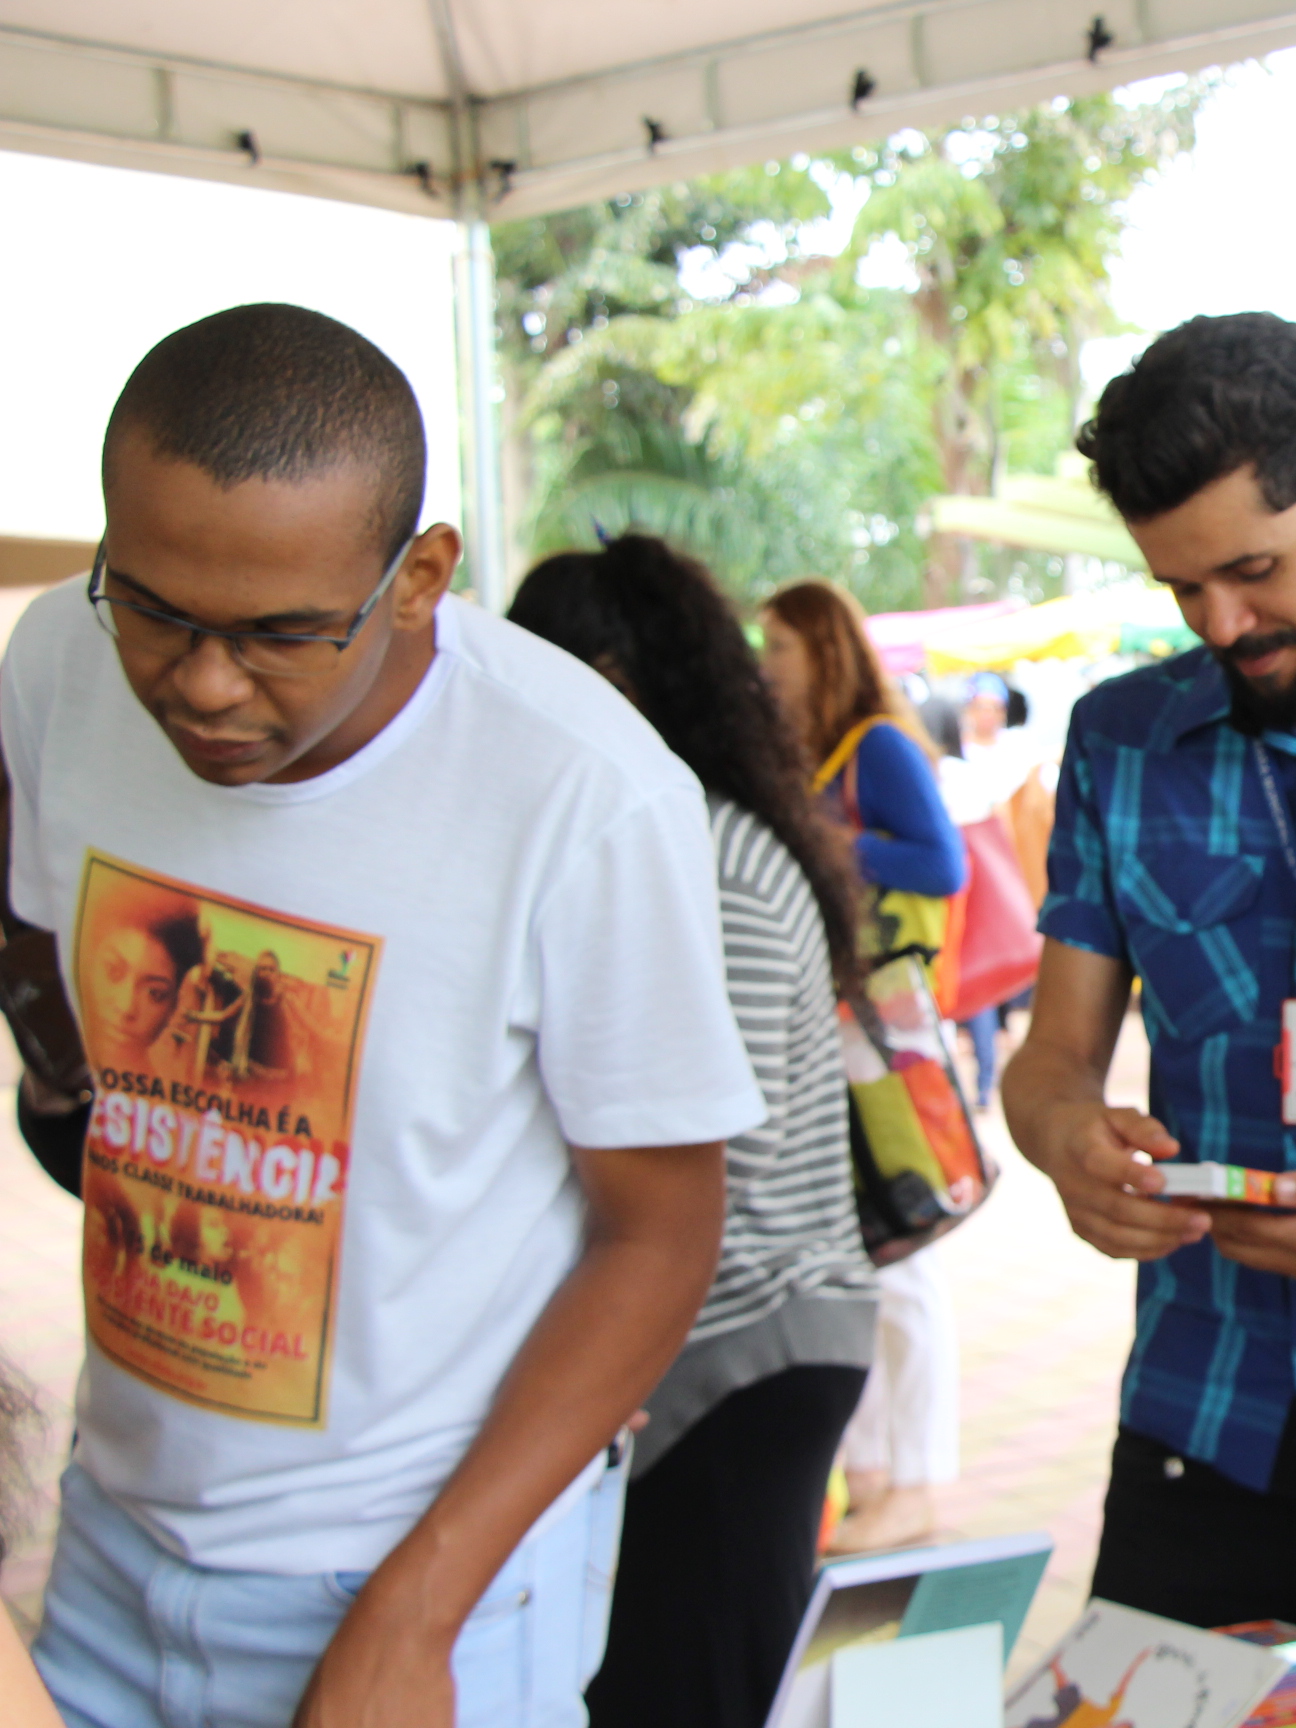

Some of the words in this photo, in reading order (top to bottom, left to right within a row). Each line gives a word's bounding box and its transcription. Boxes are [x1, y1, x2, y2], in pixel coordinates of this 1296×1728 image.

[100, 1068, 165, 1100] OSSA
[171, 1082, 270, 1131] ESCOLHA
[276, 1104, 291, 1134] É
[294, 1114, 313, 1139] A
[179, 1257, 233, 1287] maio
[201, 1315, 310, 1361] SOCIAL
